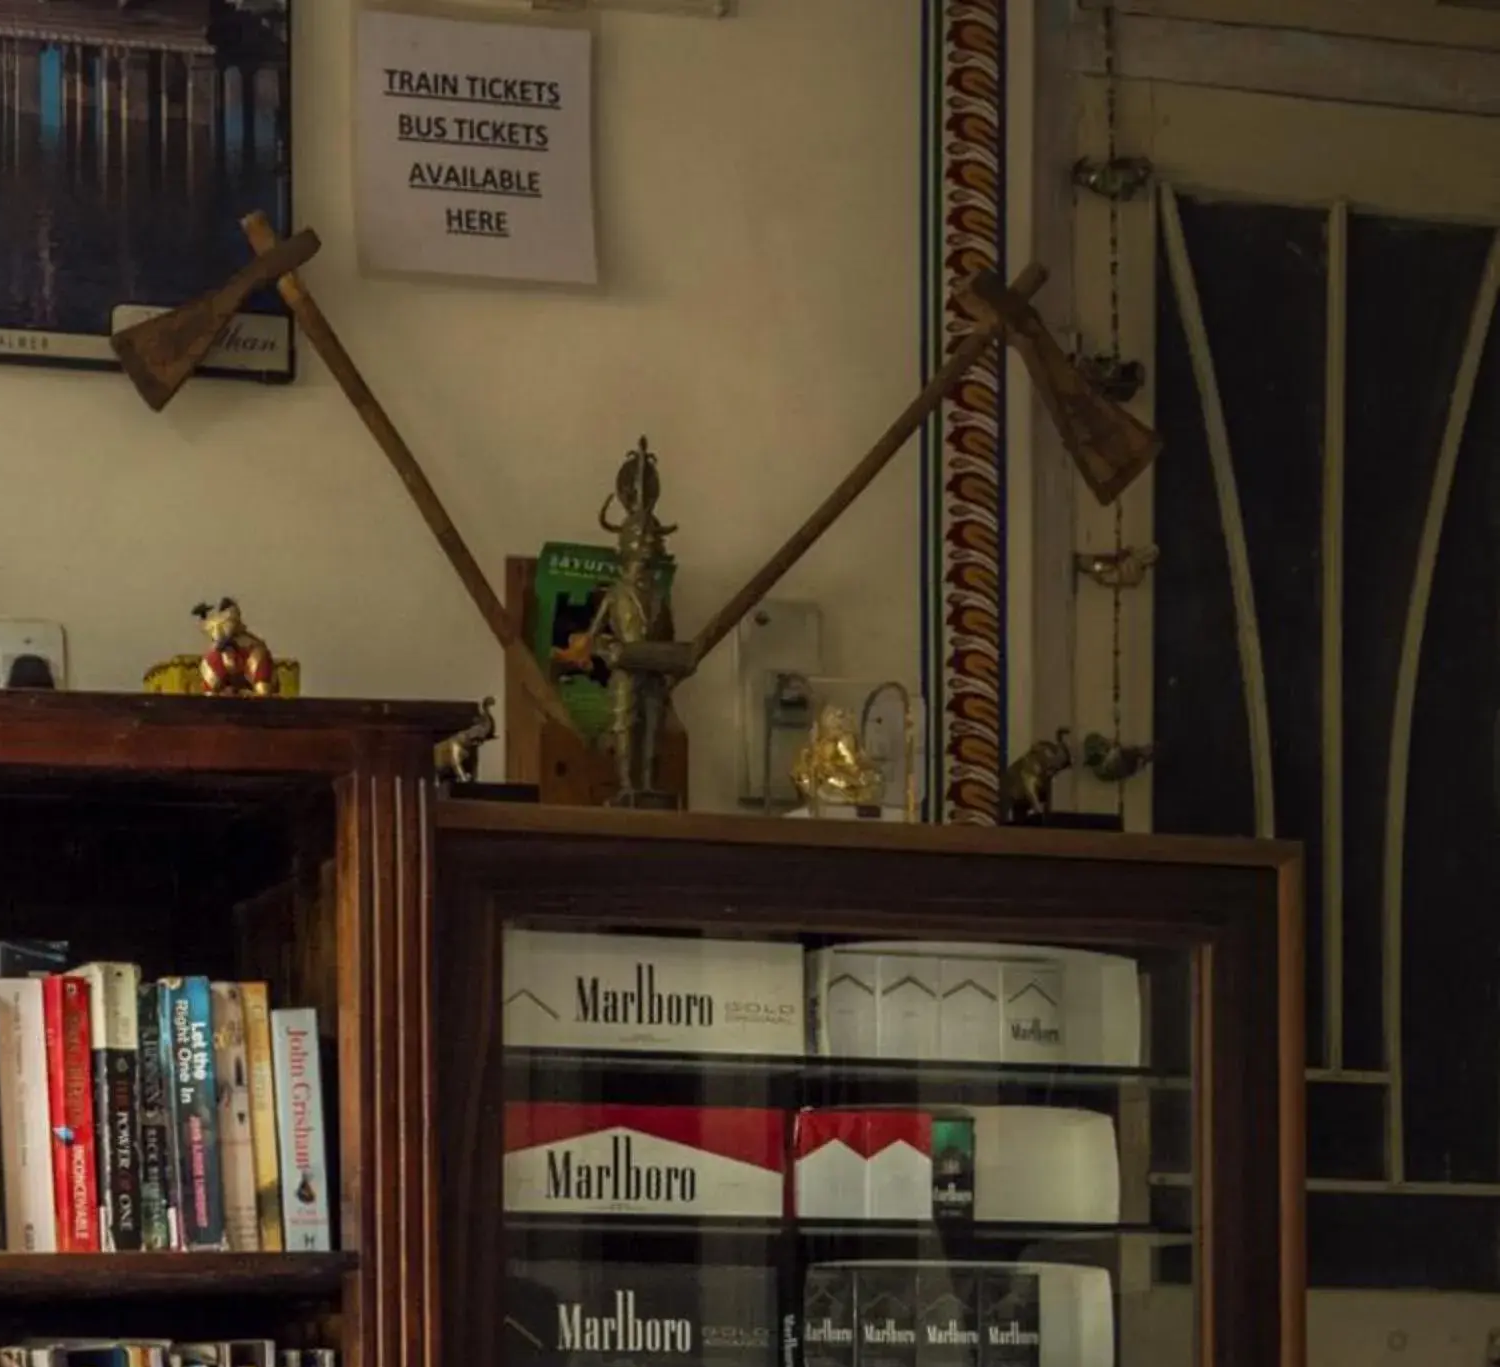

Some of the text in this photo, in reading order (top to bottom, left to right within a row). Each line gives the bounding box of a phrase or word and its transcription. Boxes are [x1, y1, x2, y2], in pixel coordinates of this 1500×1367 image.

[384, 69, 561, 104] TRAIN TICKETS
[398, 113, 549, 147] BUS TICKETS
[409, 162, 540, 193] AVAILABLE
[446, 208, 508, 232] HERE
[575, 964, 714, 1027] Marlboro
[174, 999, 196, 1105] Right One In
[191, 1021, 208, 1080] Let the
[287, 1027, 315, 1171] John Grisham
[116, 1111, 133, 1168] POWER
[546, 1135, 697, 1202] Marlboro
[118, 1194, 133, 1232] ONE
[557, 1290, 693, 1353] Marlboro
